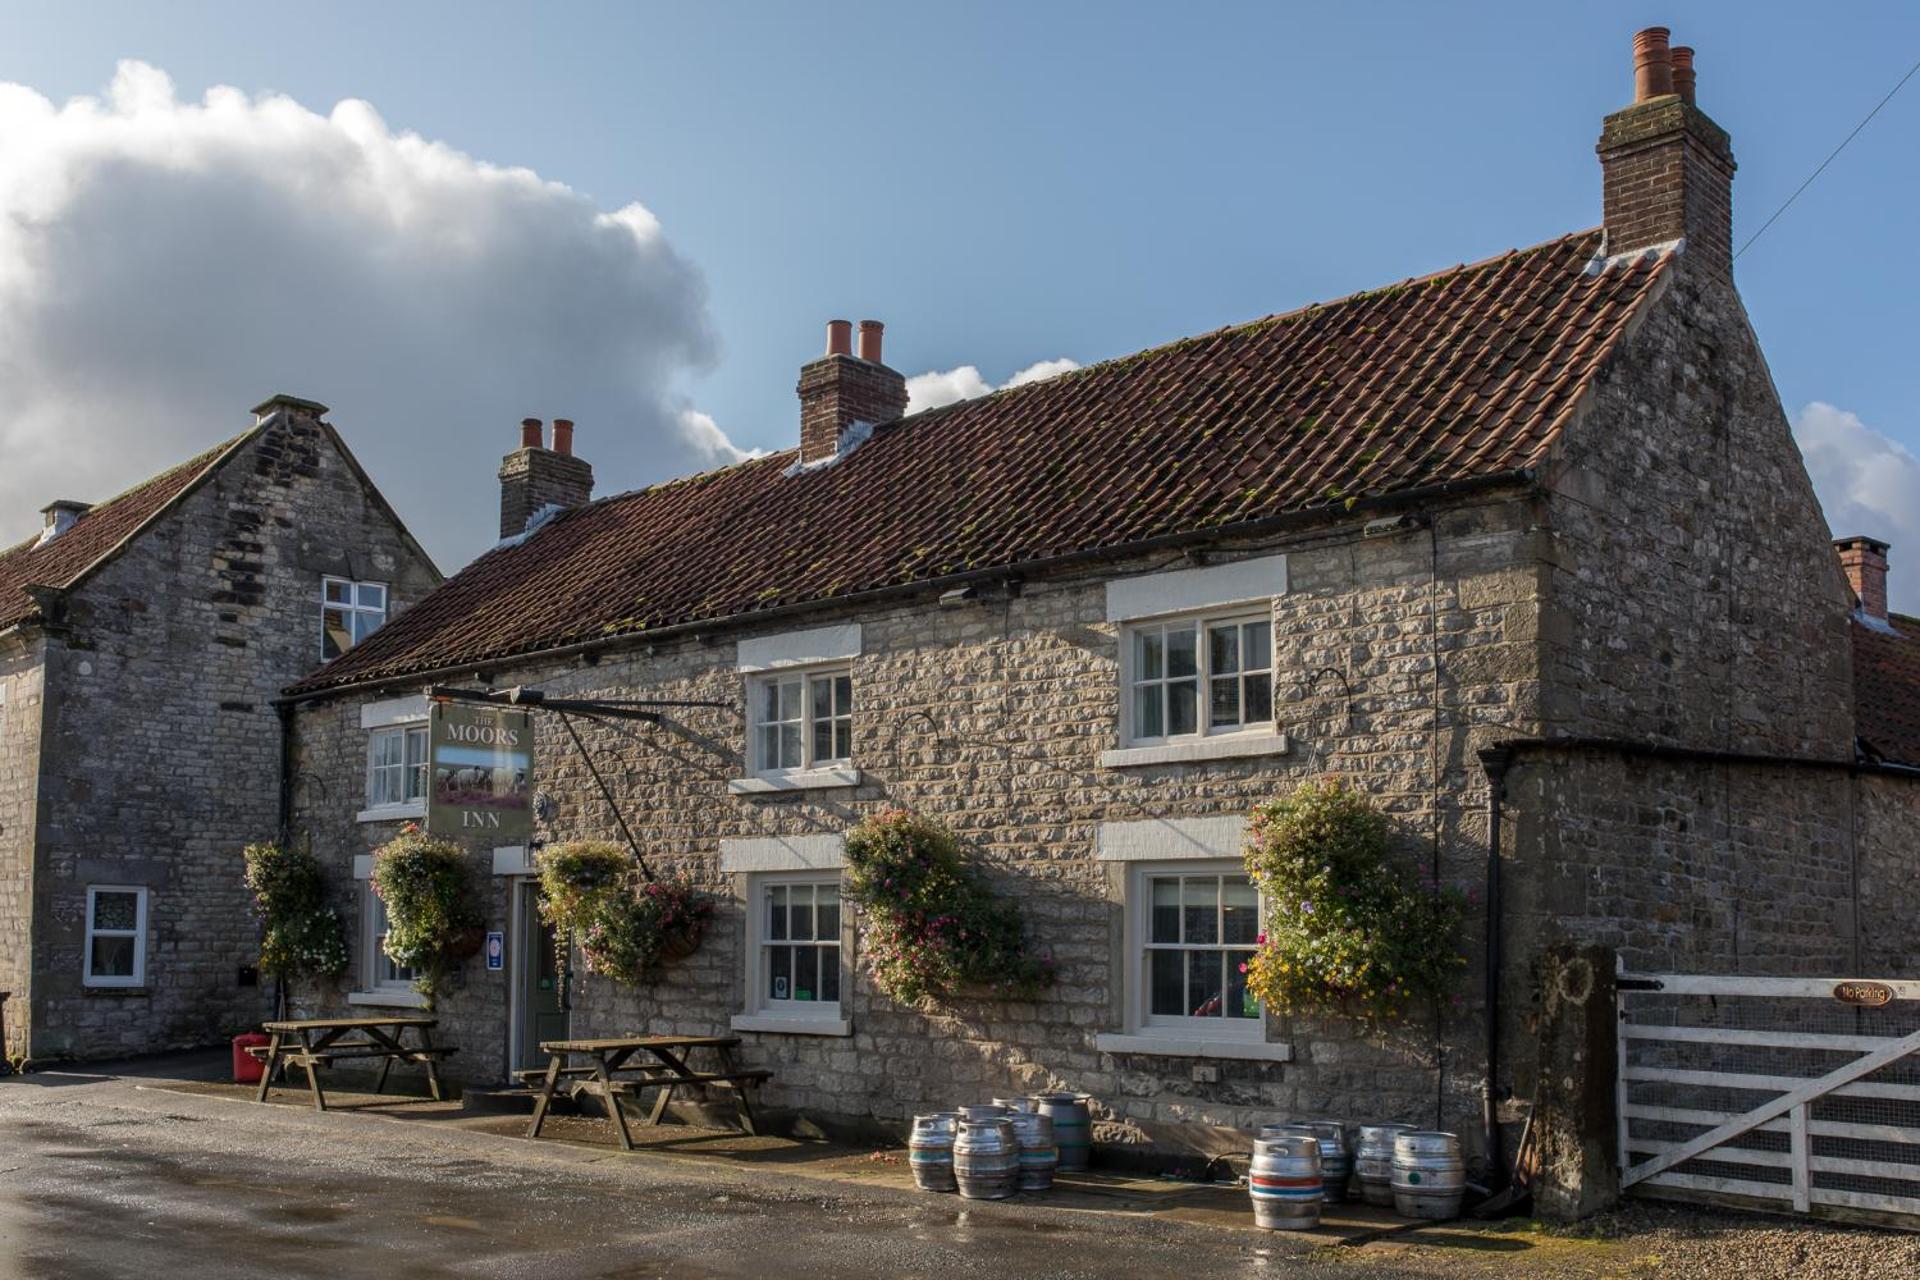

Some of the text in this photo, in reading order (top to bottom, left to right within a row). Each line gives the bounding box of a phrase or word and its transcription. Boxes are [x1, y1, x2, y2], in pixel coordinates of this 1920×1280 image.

[475, 716, 494, 725] THE
[447, 723, 518, 745] MOORS
[463, 811, 501, 828] INN
[1842, 986, 1885, 1002] No Parking
